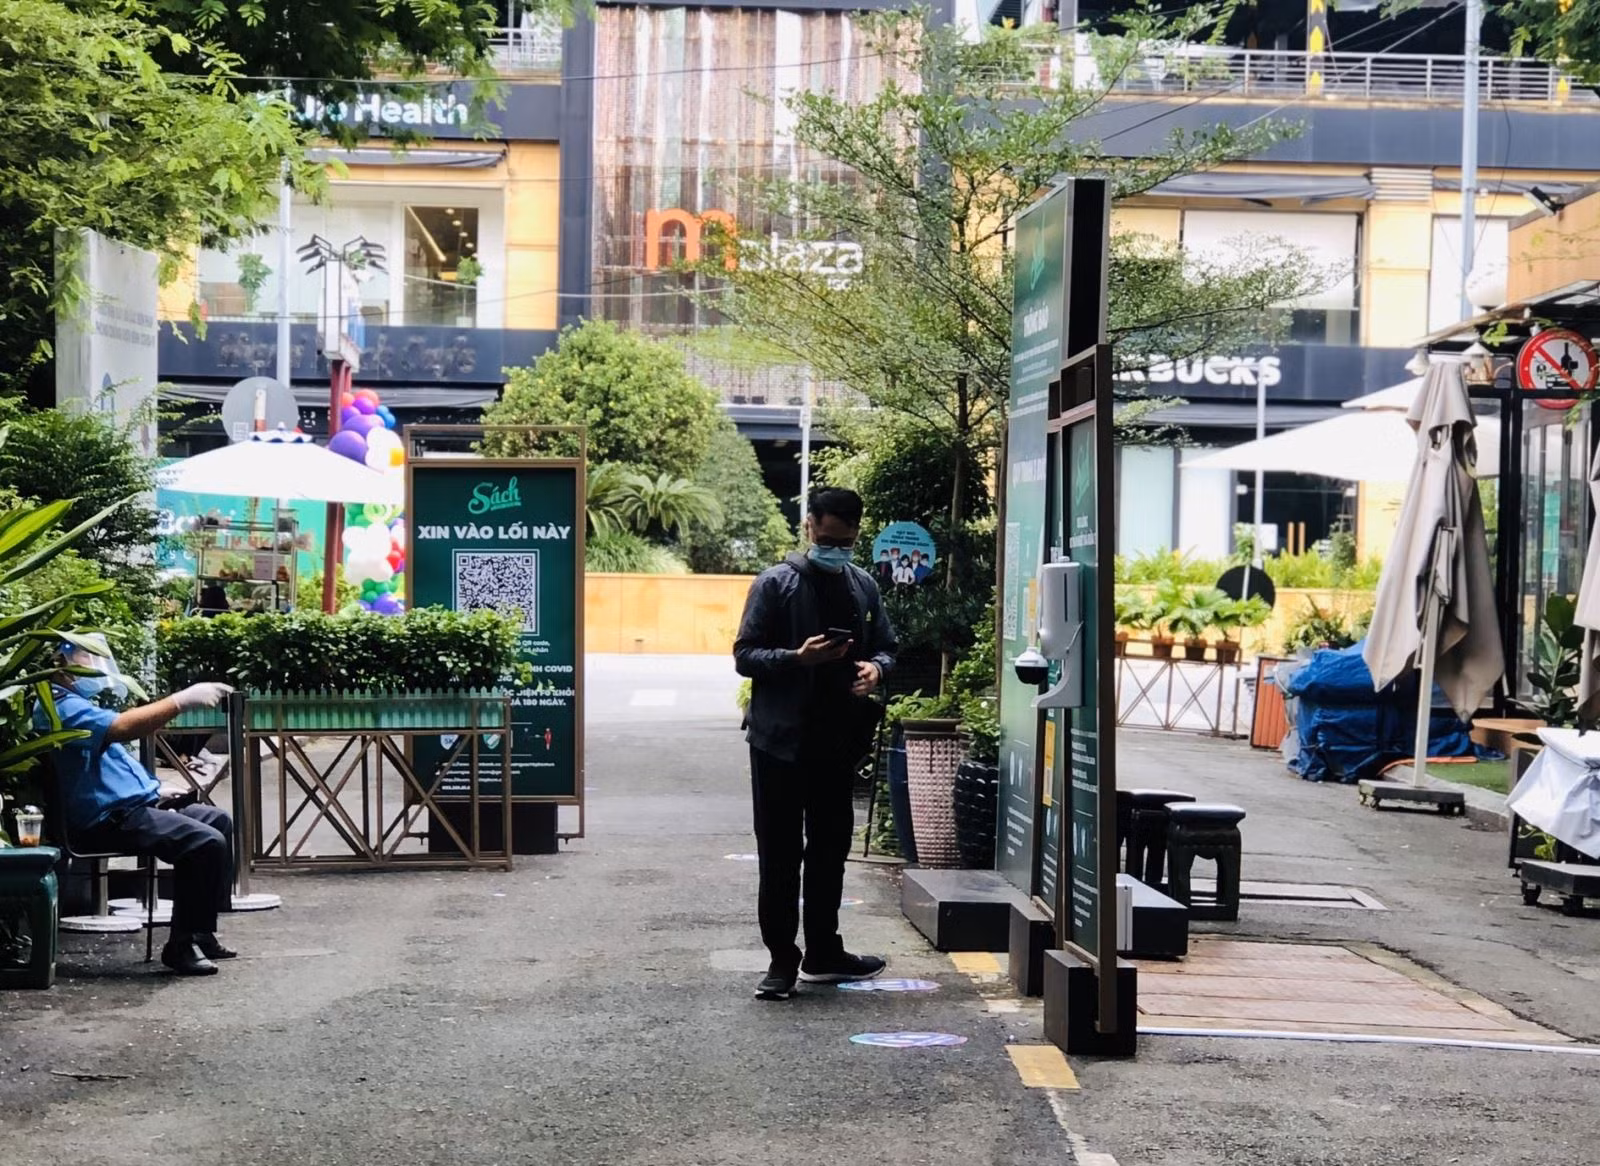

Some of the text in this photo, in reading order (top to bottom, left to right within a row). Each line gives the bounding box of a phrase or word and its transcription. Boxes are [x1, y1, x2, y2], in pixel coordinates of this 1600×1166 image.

[354, 93, 468, 125] Health
[468, 476, 521, 515] Sách
[418, 521, 571, 539] XIN VÀO LỐI NÀY
[544, 665, 573, 673] COVID
